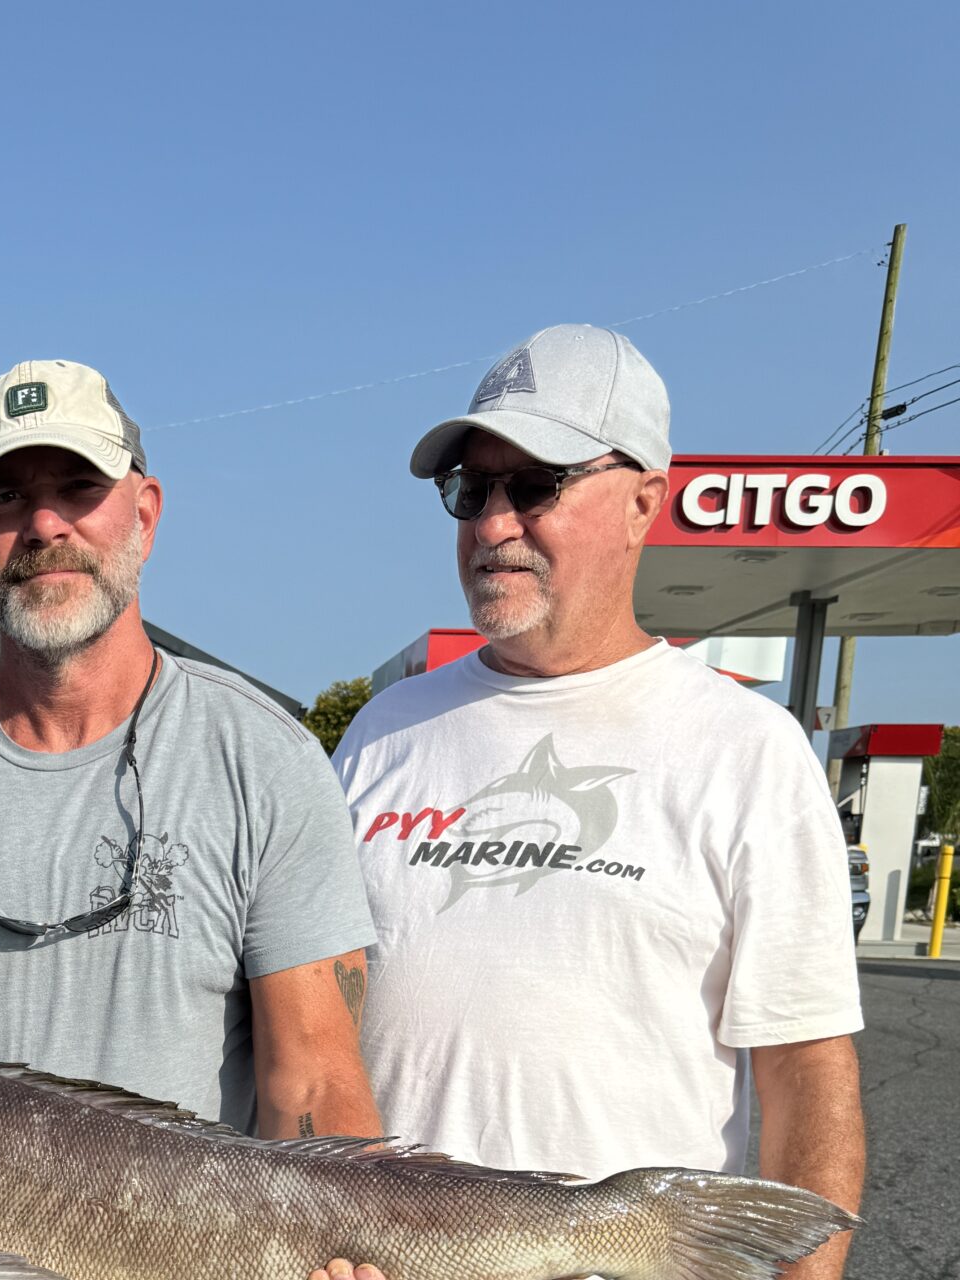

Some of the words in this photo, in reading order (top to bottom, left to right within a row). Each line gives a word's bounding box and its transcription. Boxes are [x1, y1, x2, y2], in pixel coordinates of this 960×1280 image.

[682, 473, 887, 526] CITGO
[825, 713, 831, 724] 7
[363, 807, 466, 842] PYY
